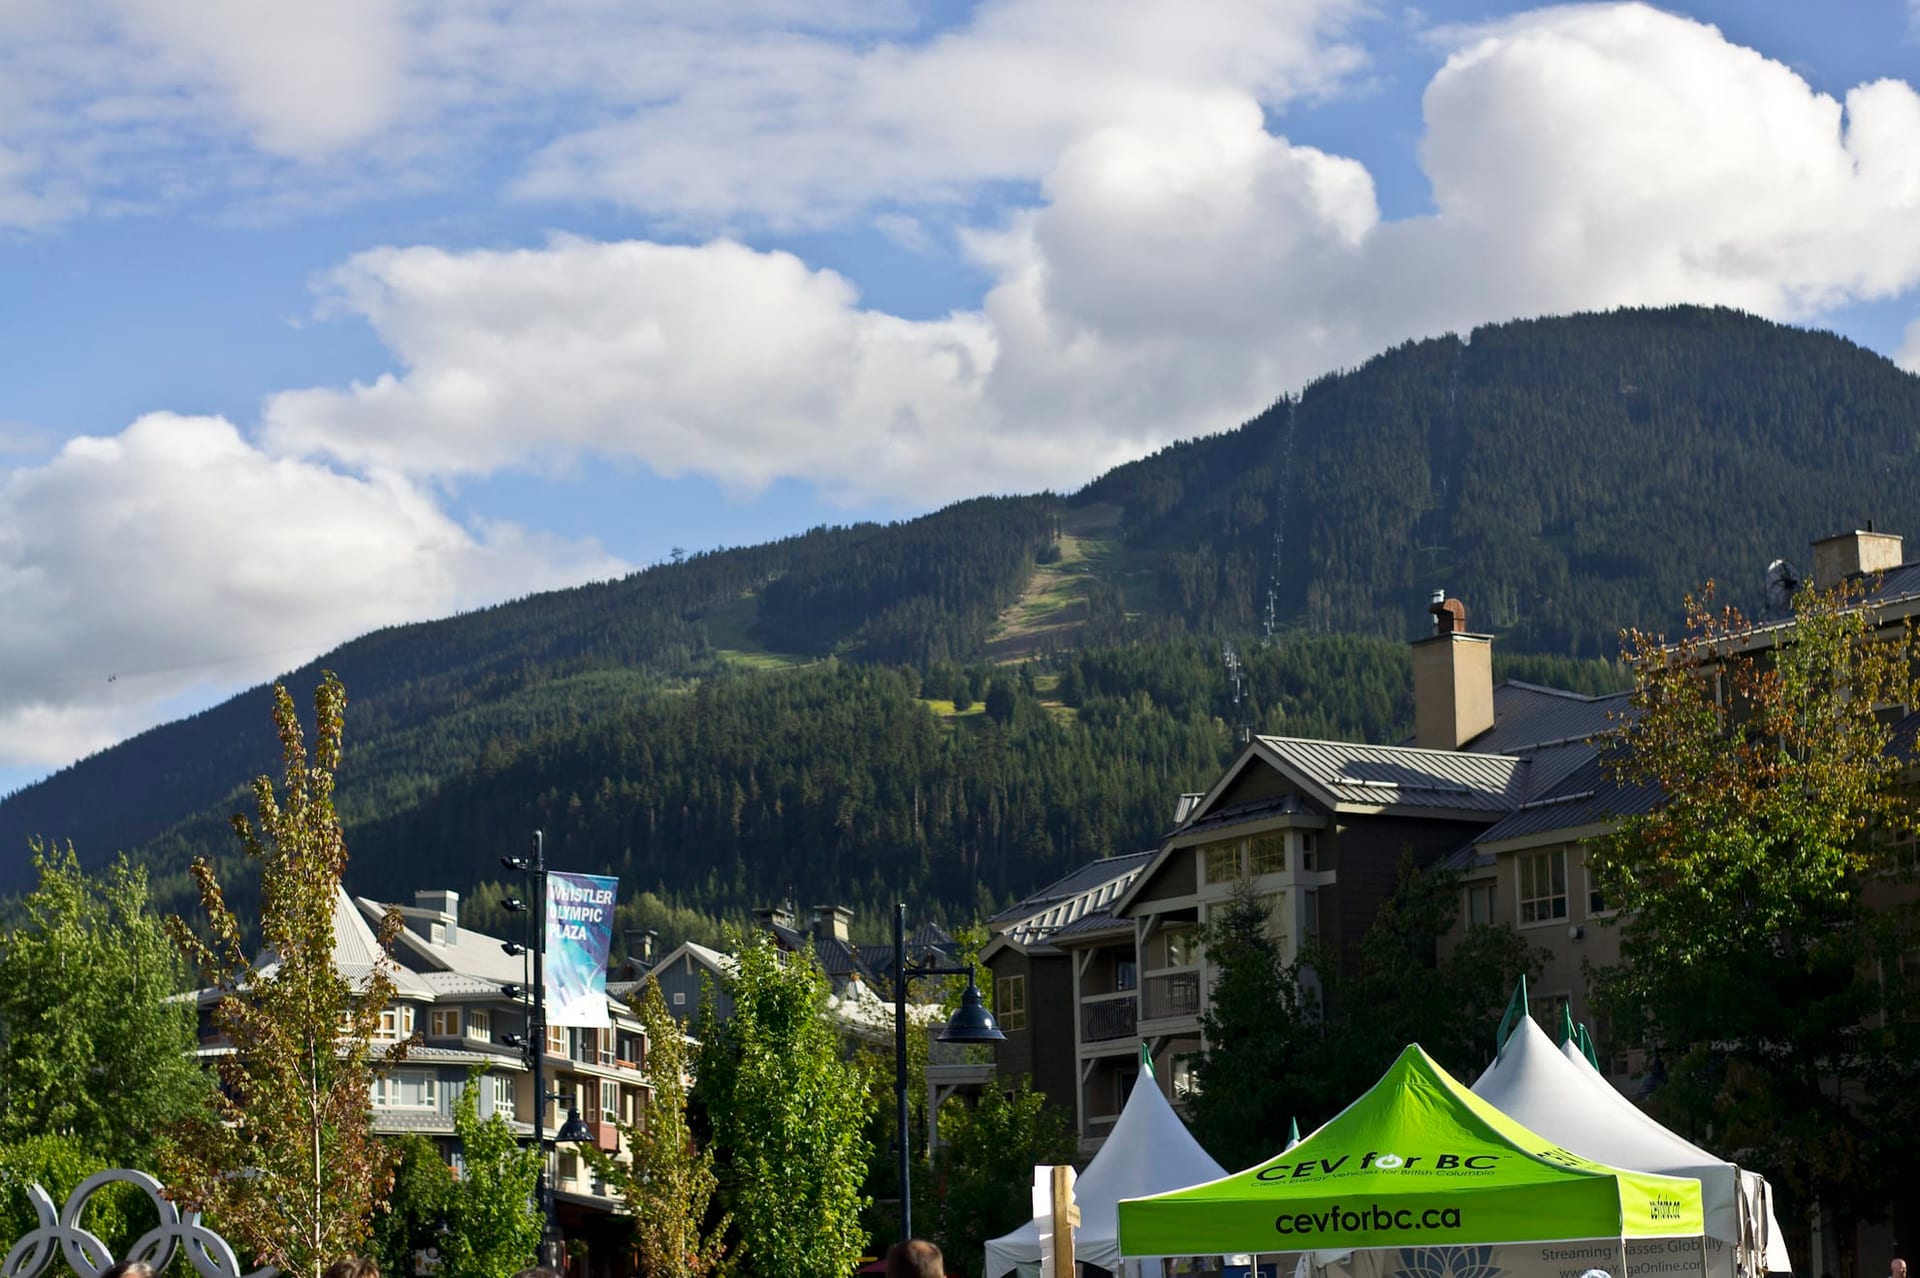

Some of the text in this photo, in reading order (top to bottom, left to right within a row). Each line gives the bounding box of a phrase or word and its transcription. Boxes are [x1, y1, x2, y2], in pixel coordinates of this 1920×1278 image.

[549, 885, 612, 904] WHISTLER
[550, 905, 603, 922] OLYMPIC
[550, 924, 587, 940] PLAZA
[1256, 1152, 1500, 1181] CEV for BC
[1436, 1169, 1495, 1177] Columbia
[1275, 1204, 1461, 1235] cevforbc.ca
[1541, 1245, 1612, 1260] Streaming
[1667, 1237, 1723, 1253] Globlly
